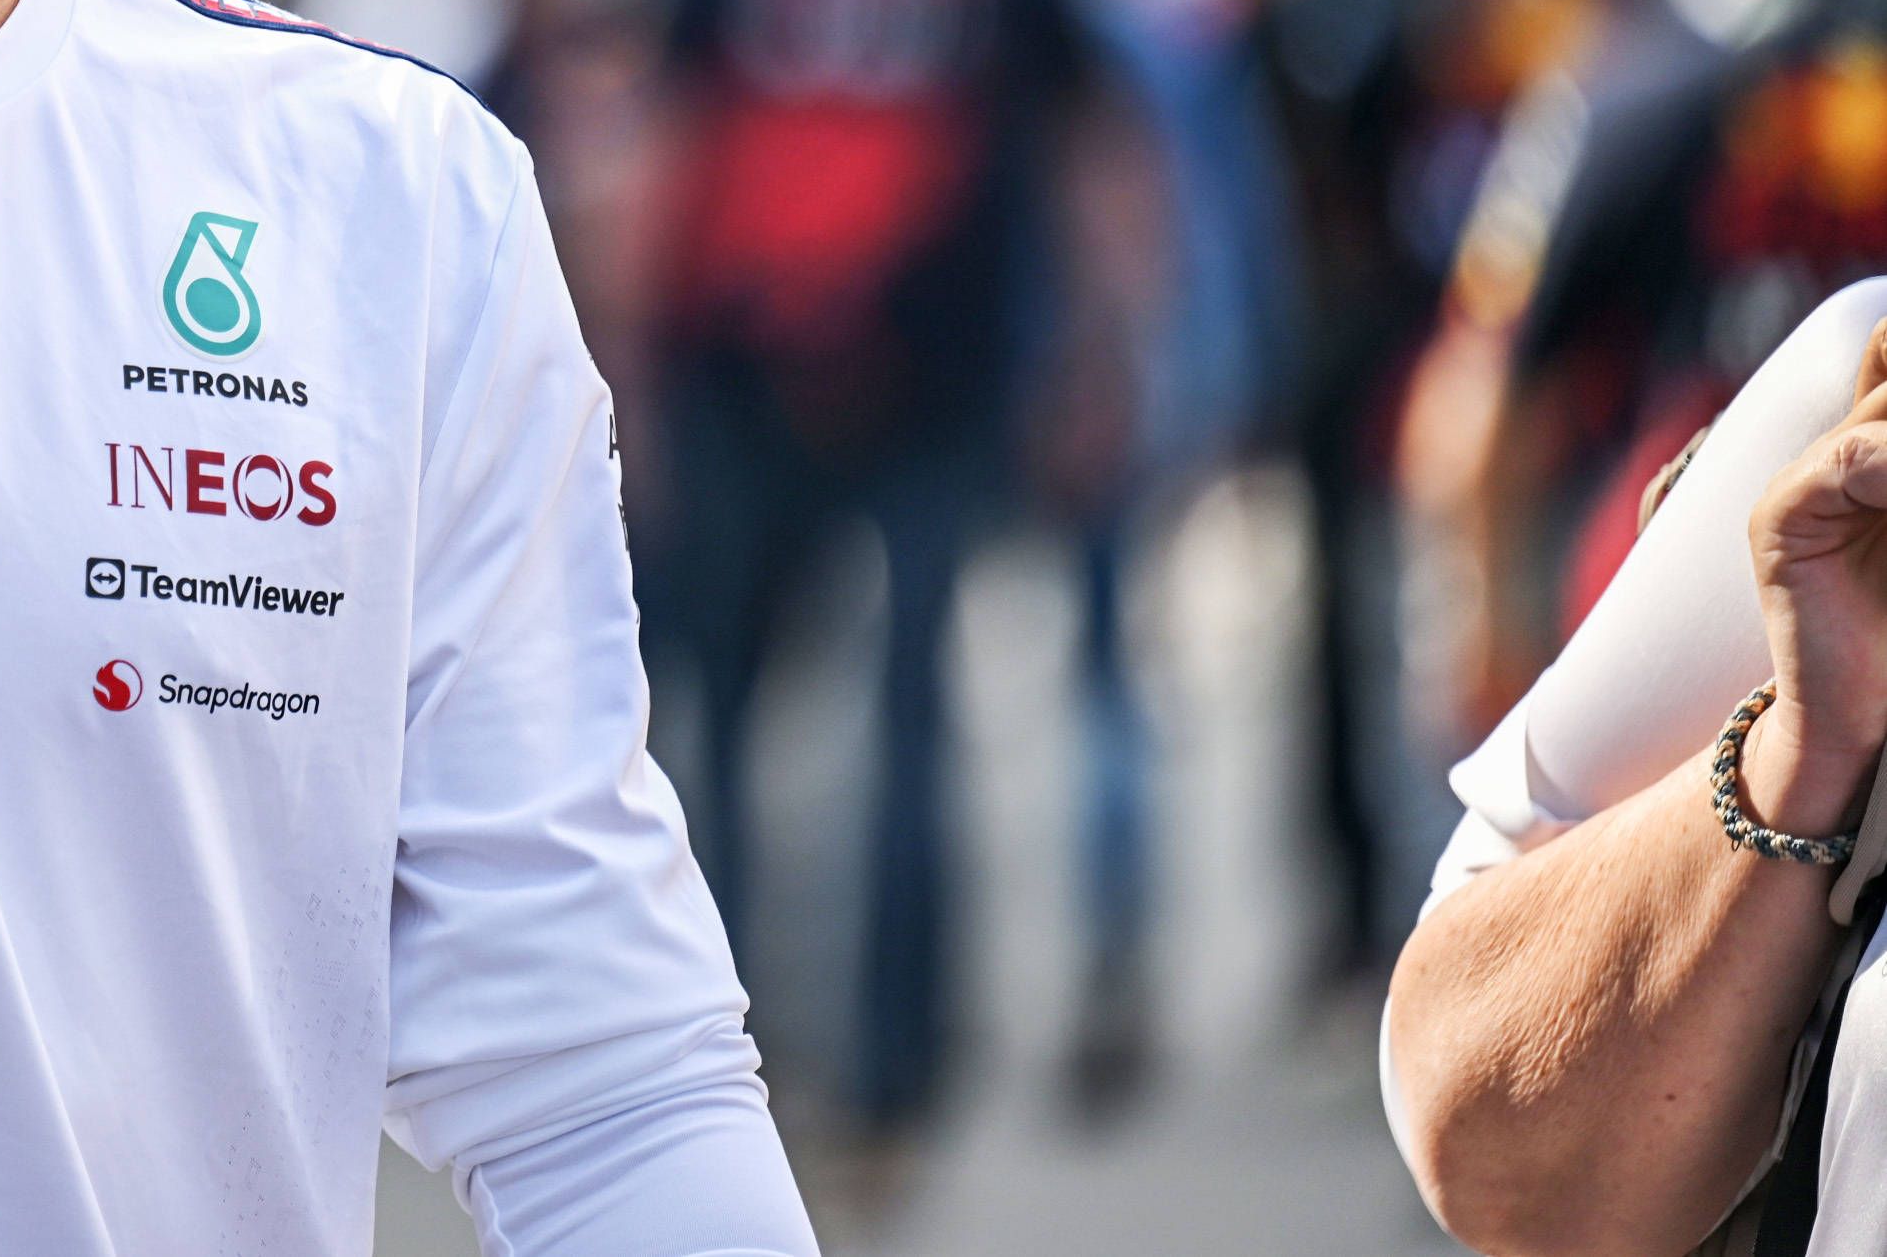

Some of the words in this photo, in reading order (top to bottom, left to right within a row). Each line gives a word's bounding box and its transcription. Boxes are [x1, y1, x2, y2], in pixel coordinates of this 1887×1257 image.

[123, 364, 308, 407] PETRONAS
[104, 443, 337, 526] INEOS
[131, 564, 344, 616] TeamViewer
[158, 674, 320, 720] Snapdragon
